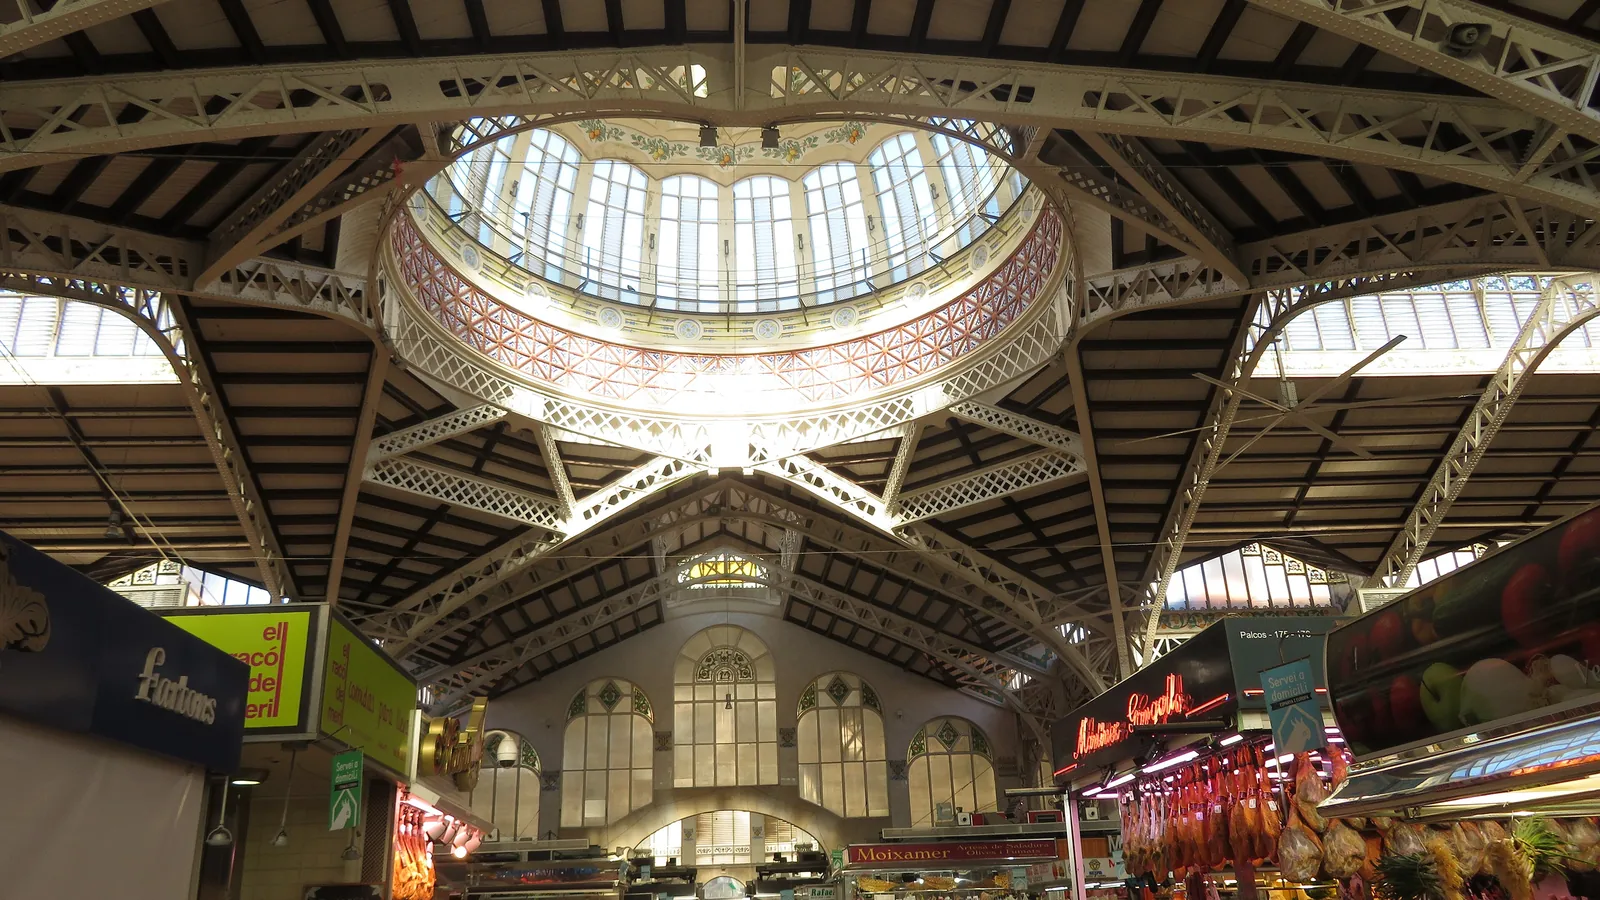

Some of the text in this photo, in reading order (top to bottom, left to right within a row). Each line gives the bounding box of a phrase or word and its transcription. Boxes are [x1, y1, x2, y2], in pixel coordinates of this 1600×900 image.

[263, 622, 283, 641] el
[1240, 631, 1268, 639] Palcos
[1275, 630, 1290, 638] 175
[1268, 671, 1305, 689] Servei a
[1271, 682, 1309, 702] domicili
[245, 698, 274, 719] eri
[336, 760, 359, 772] Servei a
[336, 769, 358, 783] domicili
[857, 848, 951, 861] Moixamer
